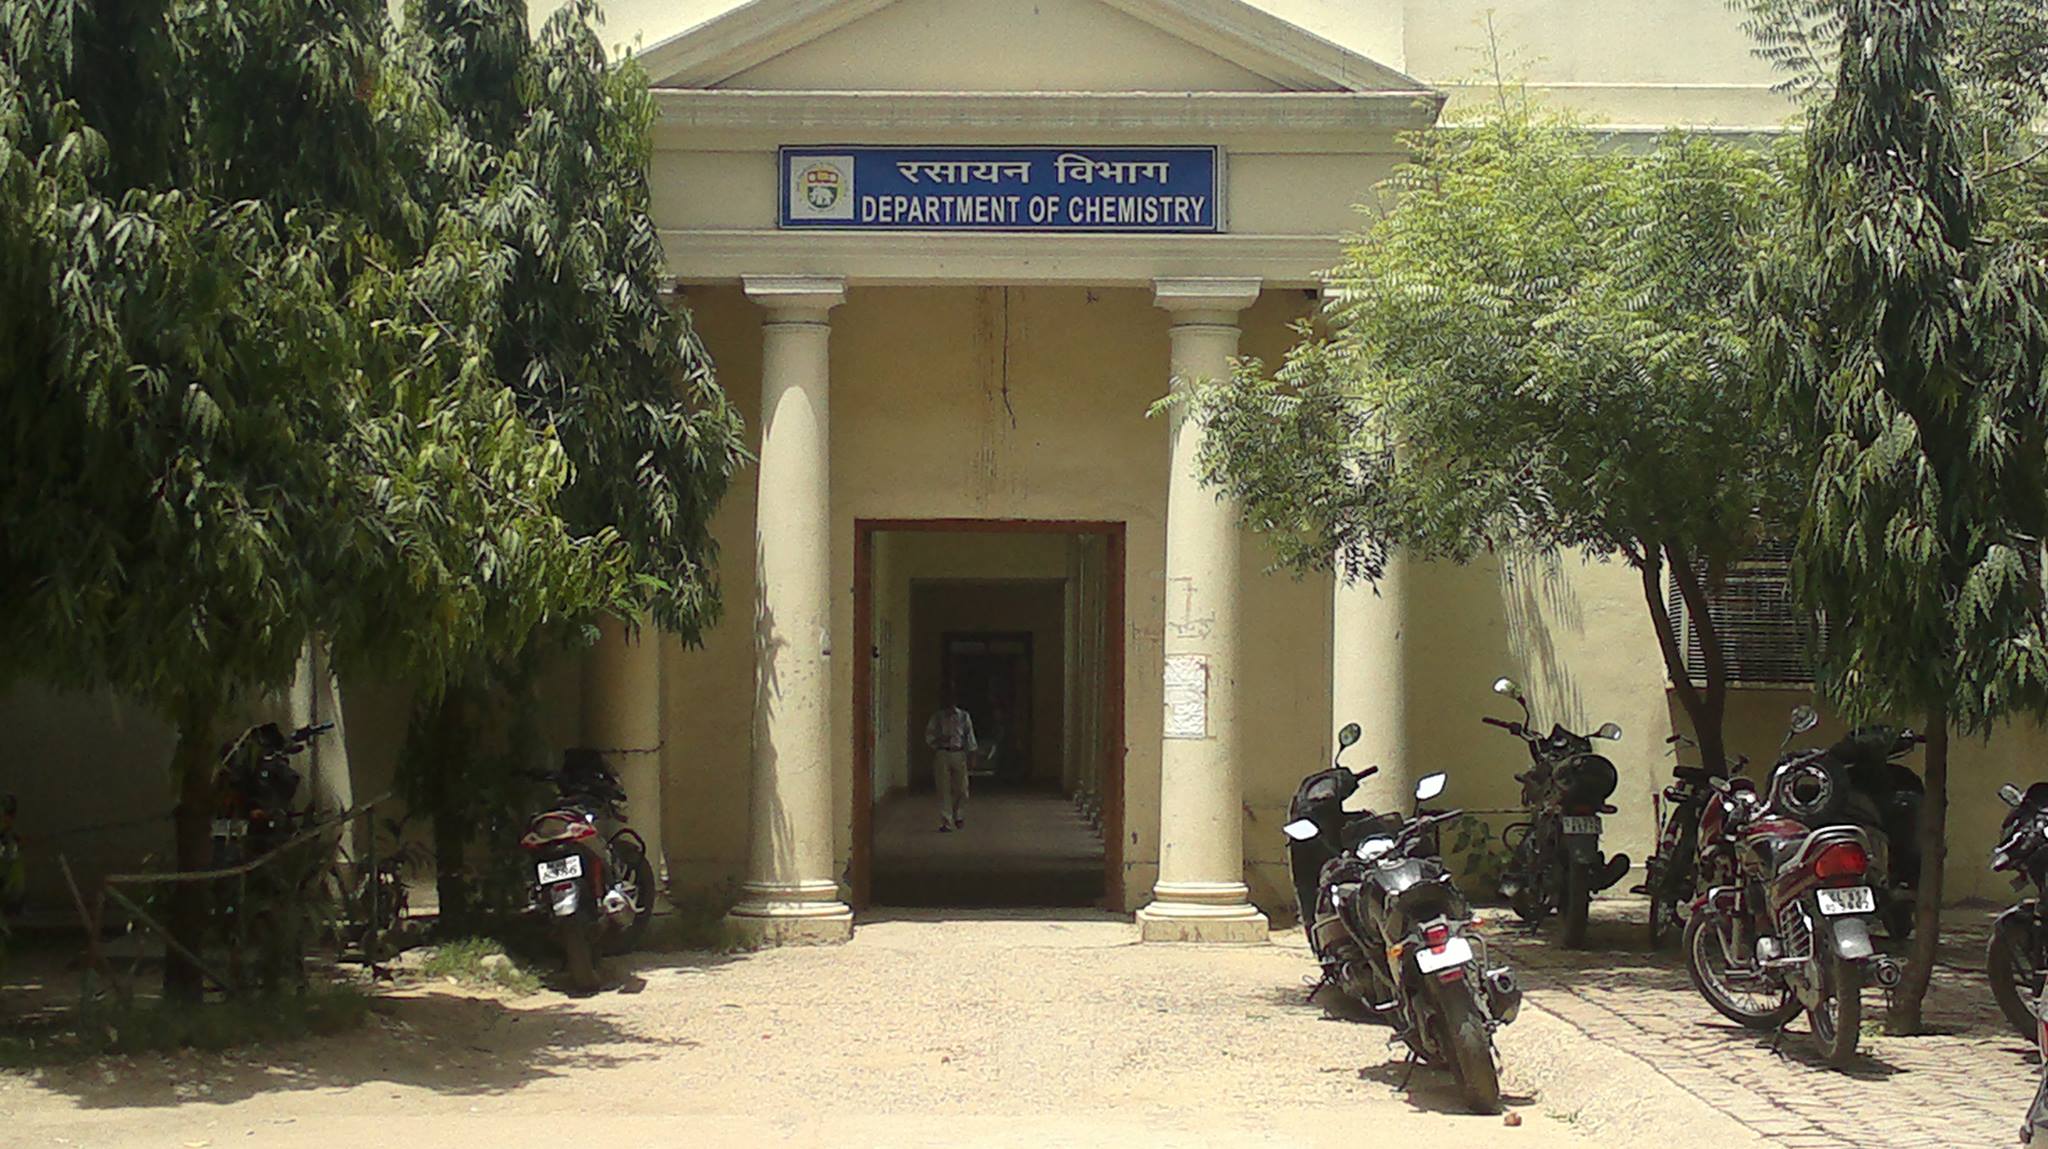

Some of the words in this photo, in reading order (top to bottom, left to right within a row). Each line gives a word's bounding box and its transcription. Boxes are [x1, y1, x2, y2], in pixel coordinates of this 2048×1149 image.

[897, 161, 1031, 184] रसायन
[1055, 153, 1169, 184] विभाग
[862, 196, 1021, 223] DEPARTMENT
[1028, 197, 1060, 223] OF
[1071, 196, 1205, 224] CHEMISTRY
